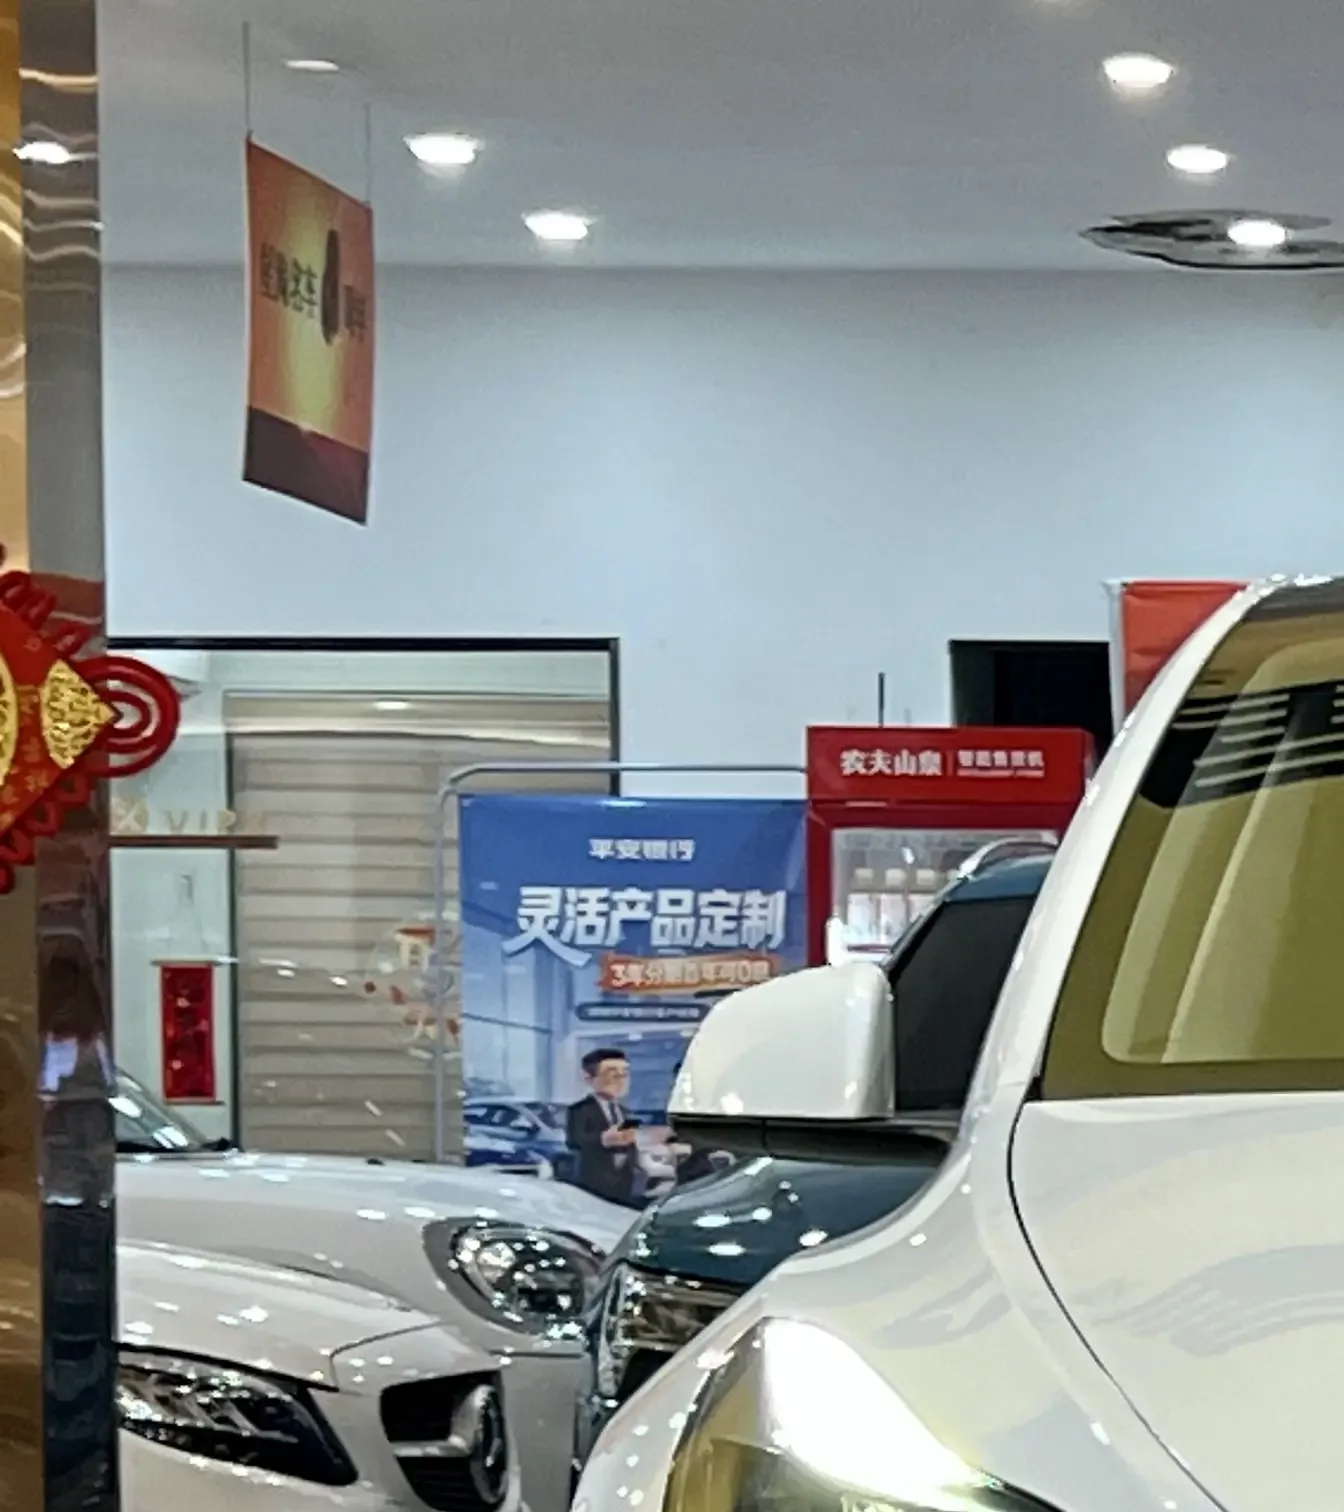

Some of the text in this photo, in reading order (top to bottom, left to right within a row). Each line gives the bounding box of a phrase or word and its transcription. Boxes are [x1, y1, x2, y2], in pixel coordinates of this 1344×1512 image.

[840, 748, 943, 776] 农夫山泉
[502, 885, 788, 968] 灵活产品定制
